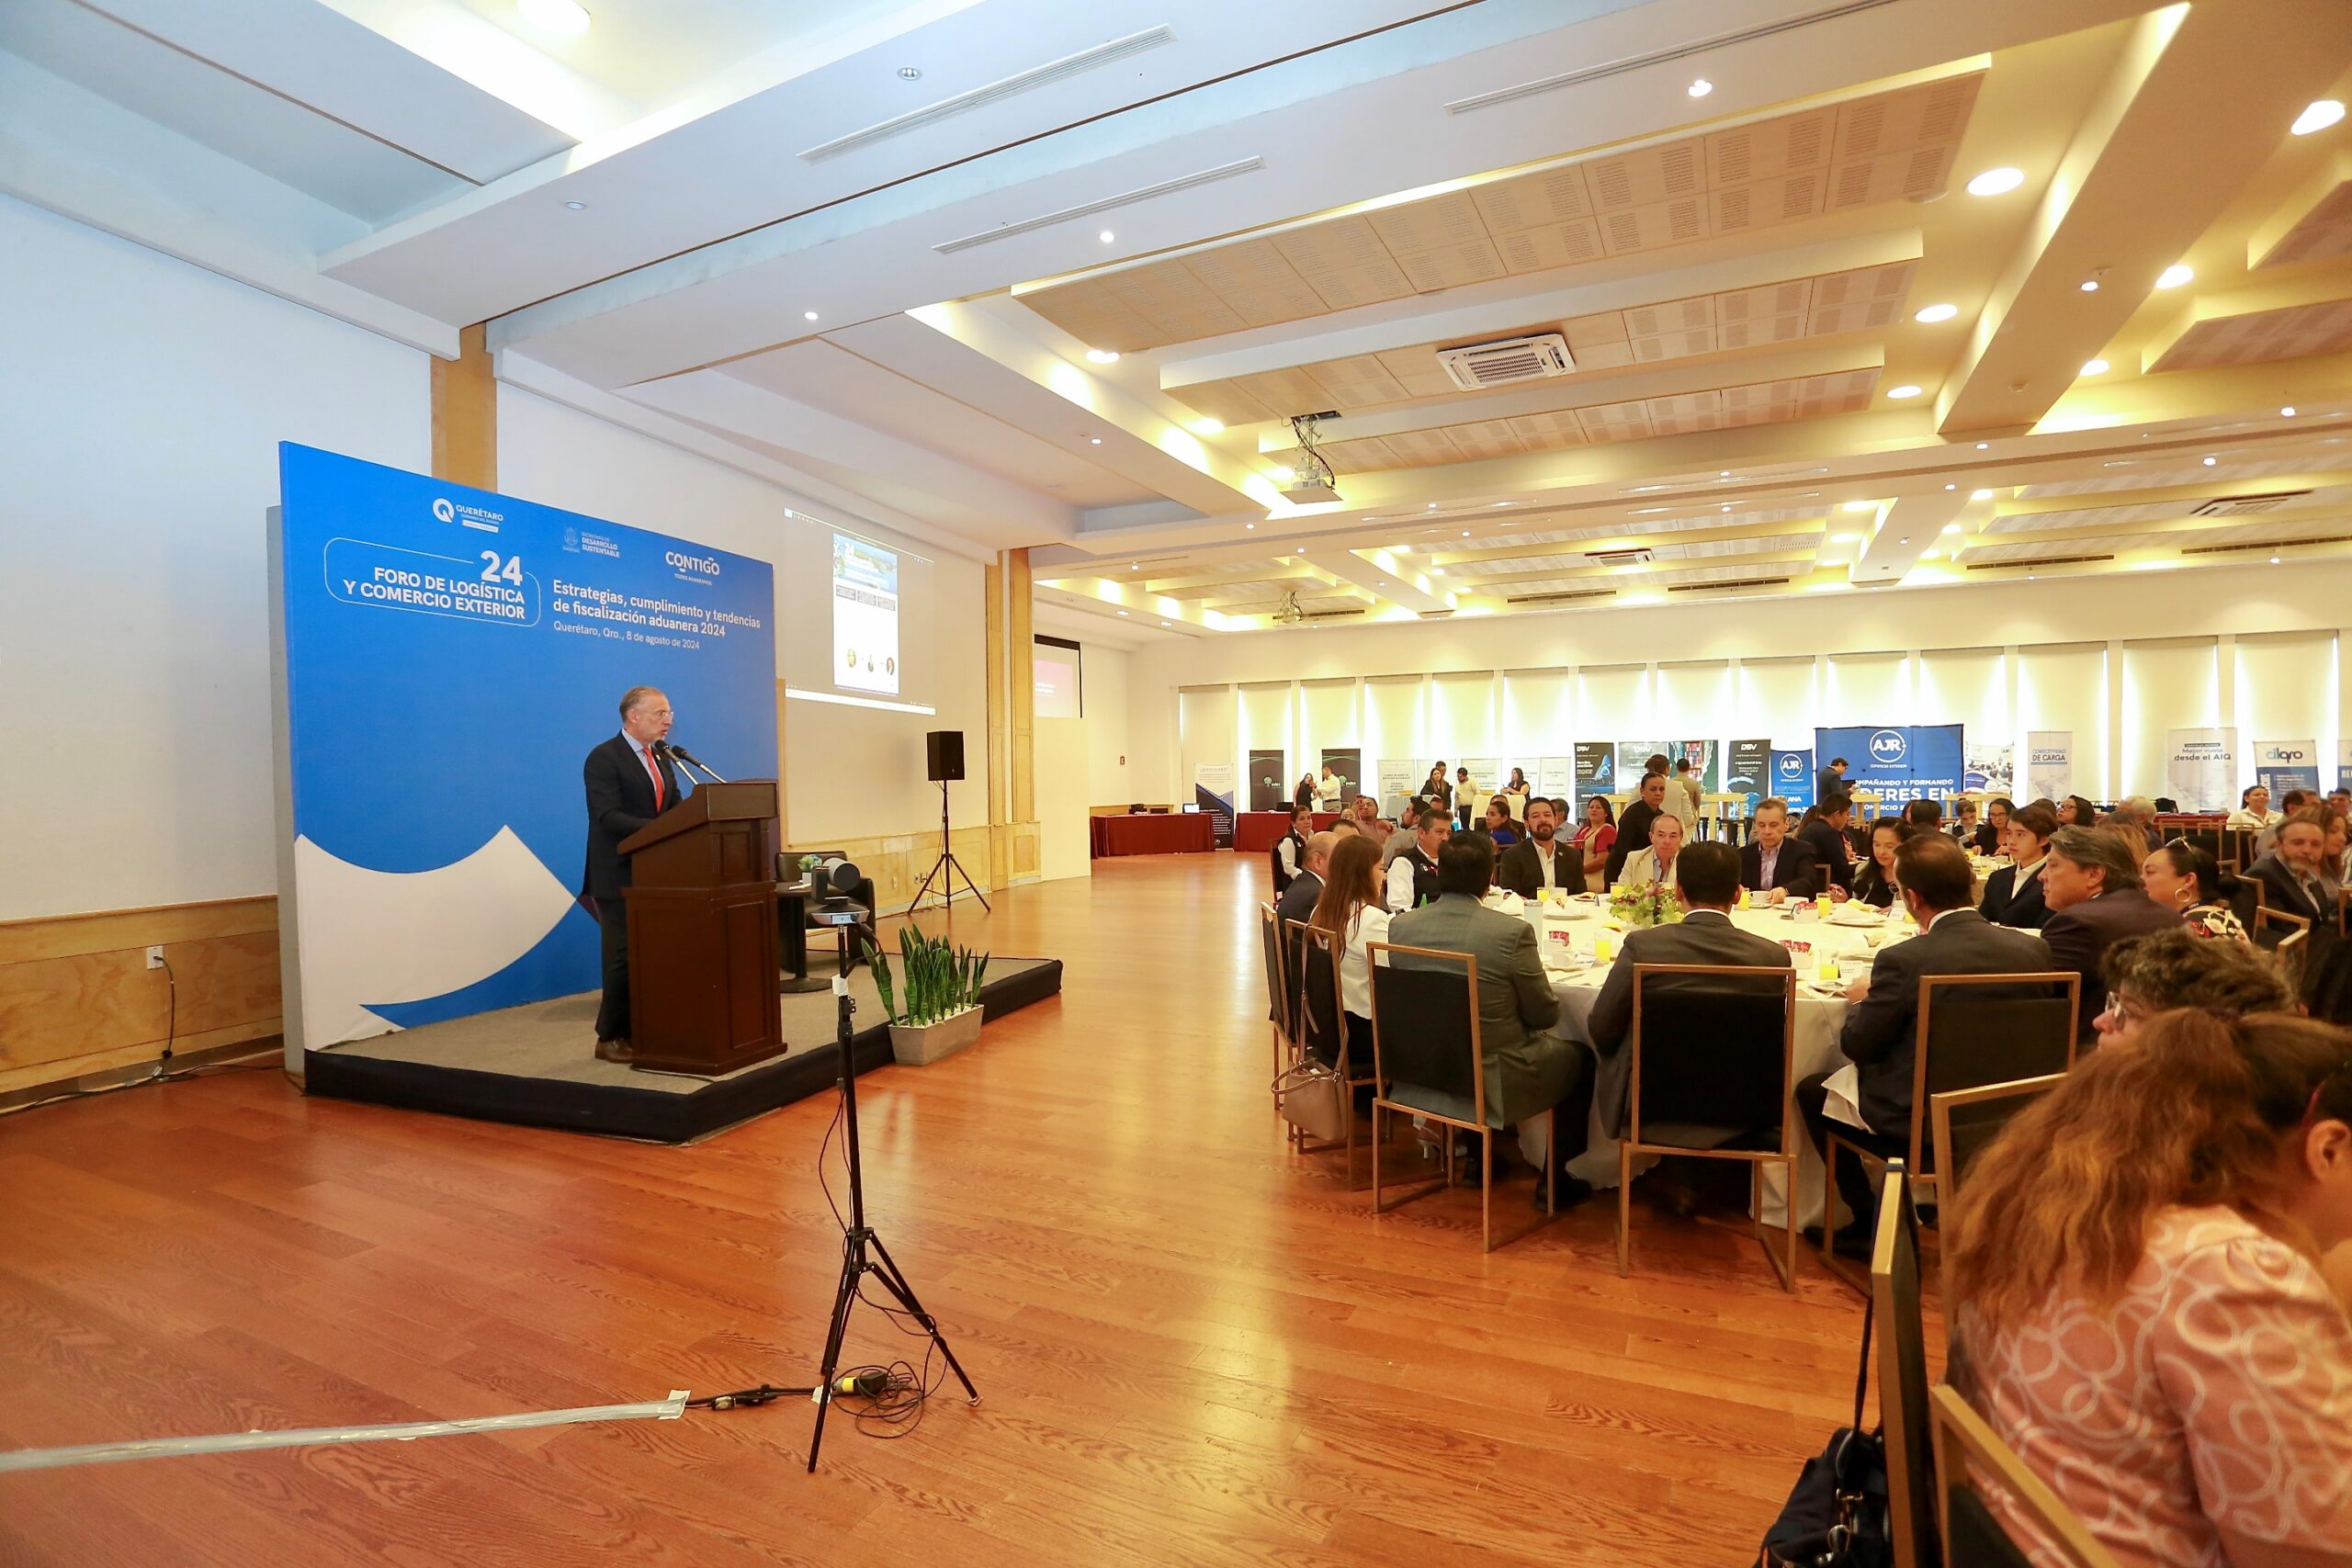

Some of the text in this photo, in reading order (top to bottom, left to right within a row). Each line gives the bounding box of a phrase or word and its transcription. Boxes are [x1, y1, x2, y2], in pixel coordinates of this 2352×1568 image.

[456, 504, 503, 522] QUERÉTARO
[582, 536, 618, 550] DESARROLLO
[582, 544, 621, 558] SUSTENTABLE
[480, 550, 524, 586] 24
[665, 551, 720, 576] CONTIGO
[374, 566, 526, 604] FORO DE LOGÍSTICA
[343, 579, 526, 620] Y COMERCIO EXTERIOR
[552, 579, 762, 629] Estrategias, cumplimiento y tendencias
[552, 598, 727, 637] de fiscalización aduanera 2024
[553, 620, 602, 637] Querétaro,
[626, 630, 633, 641] 8
[633, 631, 644, 643] de
[645, 635, 671, 646] agosto
[671, 636, 682, 647] de
[682, 637, 700, 649] 2024
[1872, 739, 1903, 751] AJR
[1782, 760, 1801, 770] AJR
[1855, 778, 1901, 786] MPAÑANDO
[1909, 778, 1954, 786] FORMANDO
[1928, 786, 1954, 801] EN
